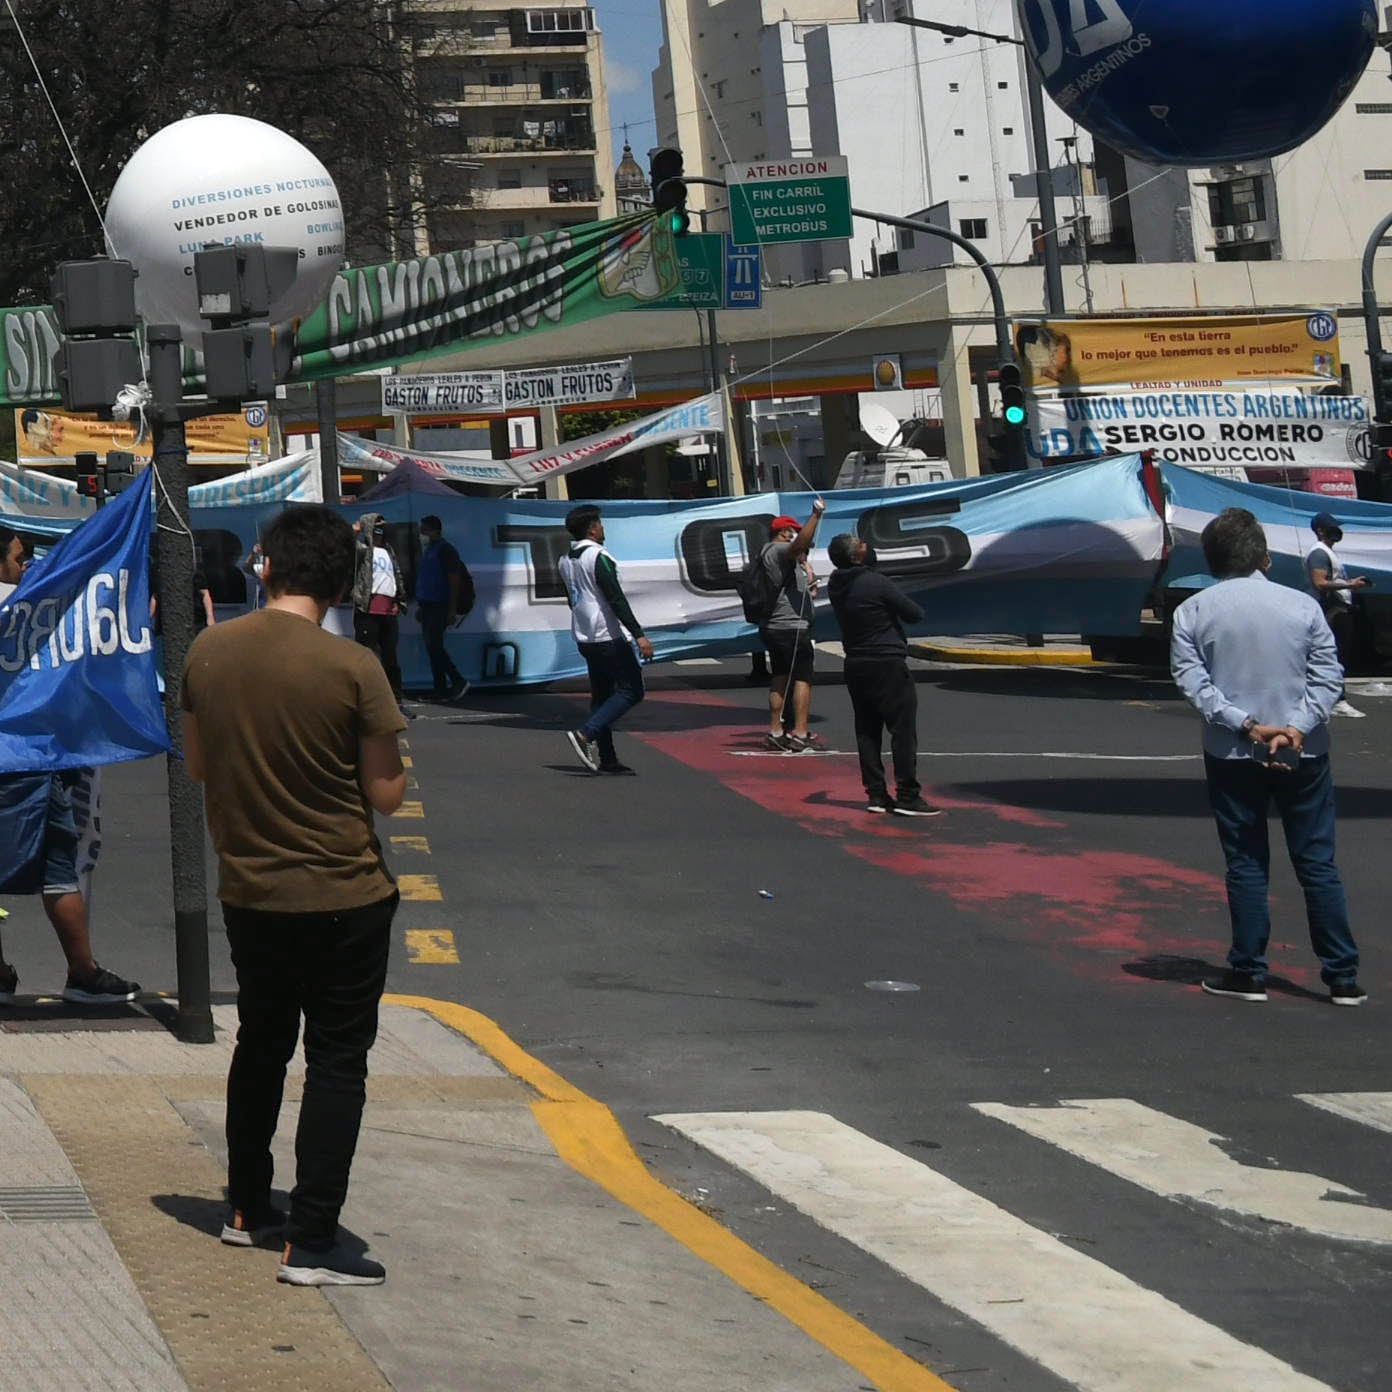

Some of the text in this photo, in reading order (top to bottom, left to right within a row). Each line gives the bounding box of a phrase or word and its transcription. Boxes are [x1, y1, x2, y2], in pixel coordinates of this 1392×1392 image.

[746, 161, 828, 179] ATENCION
[172, 184, 272, 209] DIVERSIONES
[752, 186, 824, 201] FIN CARRIL
[174, 209, 258, 232] VENDEDOR
[264, 206, 282, 217] DE
[753, 203, 826, 218] EXCLUSIVO
[755, 220, 828, 236] METROBUS
[1169, 333, 1195, 342] esta
[1199, 331, 1232, 341] tierra
[1081, 350, 1092, 360] lo
[1097, 349, 1131, 361] mejor
[1135, 349, 1157, 360] que
[1161, 347, 1213, 358] tenemos
[1217, 347, 1231, 356] es
[1234, 345, 1246, 355] el
[505, 372, 614, 402] GASTON FRUTOS
[1130, 379, 1223, 390] LEALTAD Y UNIDAD
[384, 384, 484, 407] GASTON FRUTOS
[1066, 393, 1365, 421] UNION DOCENTES ARGENTINOS
[1024, 423, 1324, 459] UDA SERGIO ROMERO
[1152, 445, 1296, 463] CONDUCCION
[87, 476, 97, 493] 5
